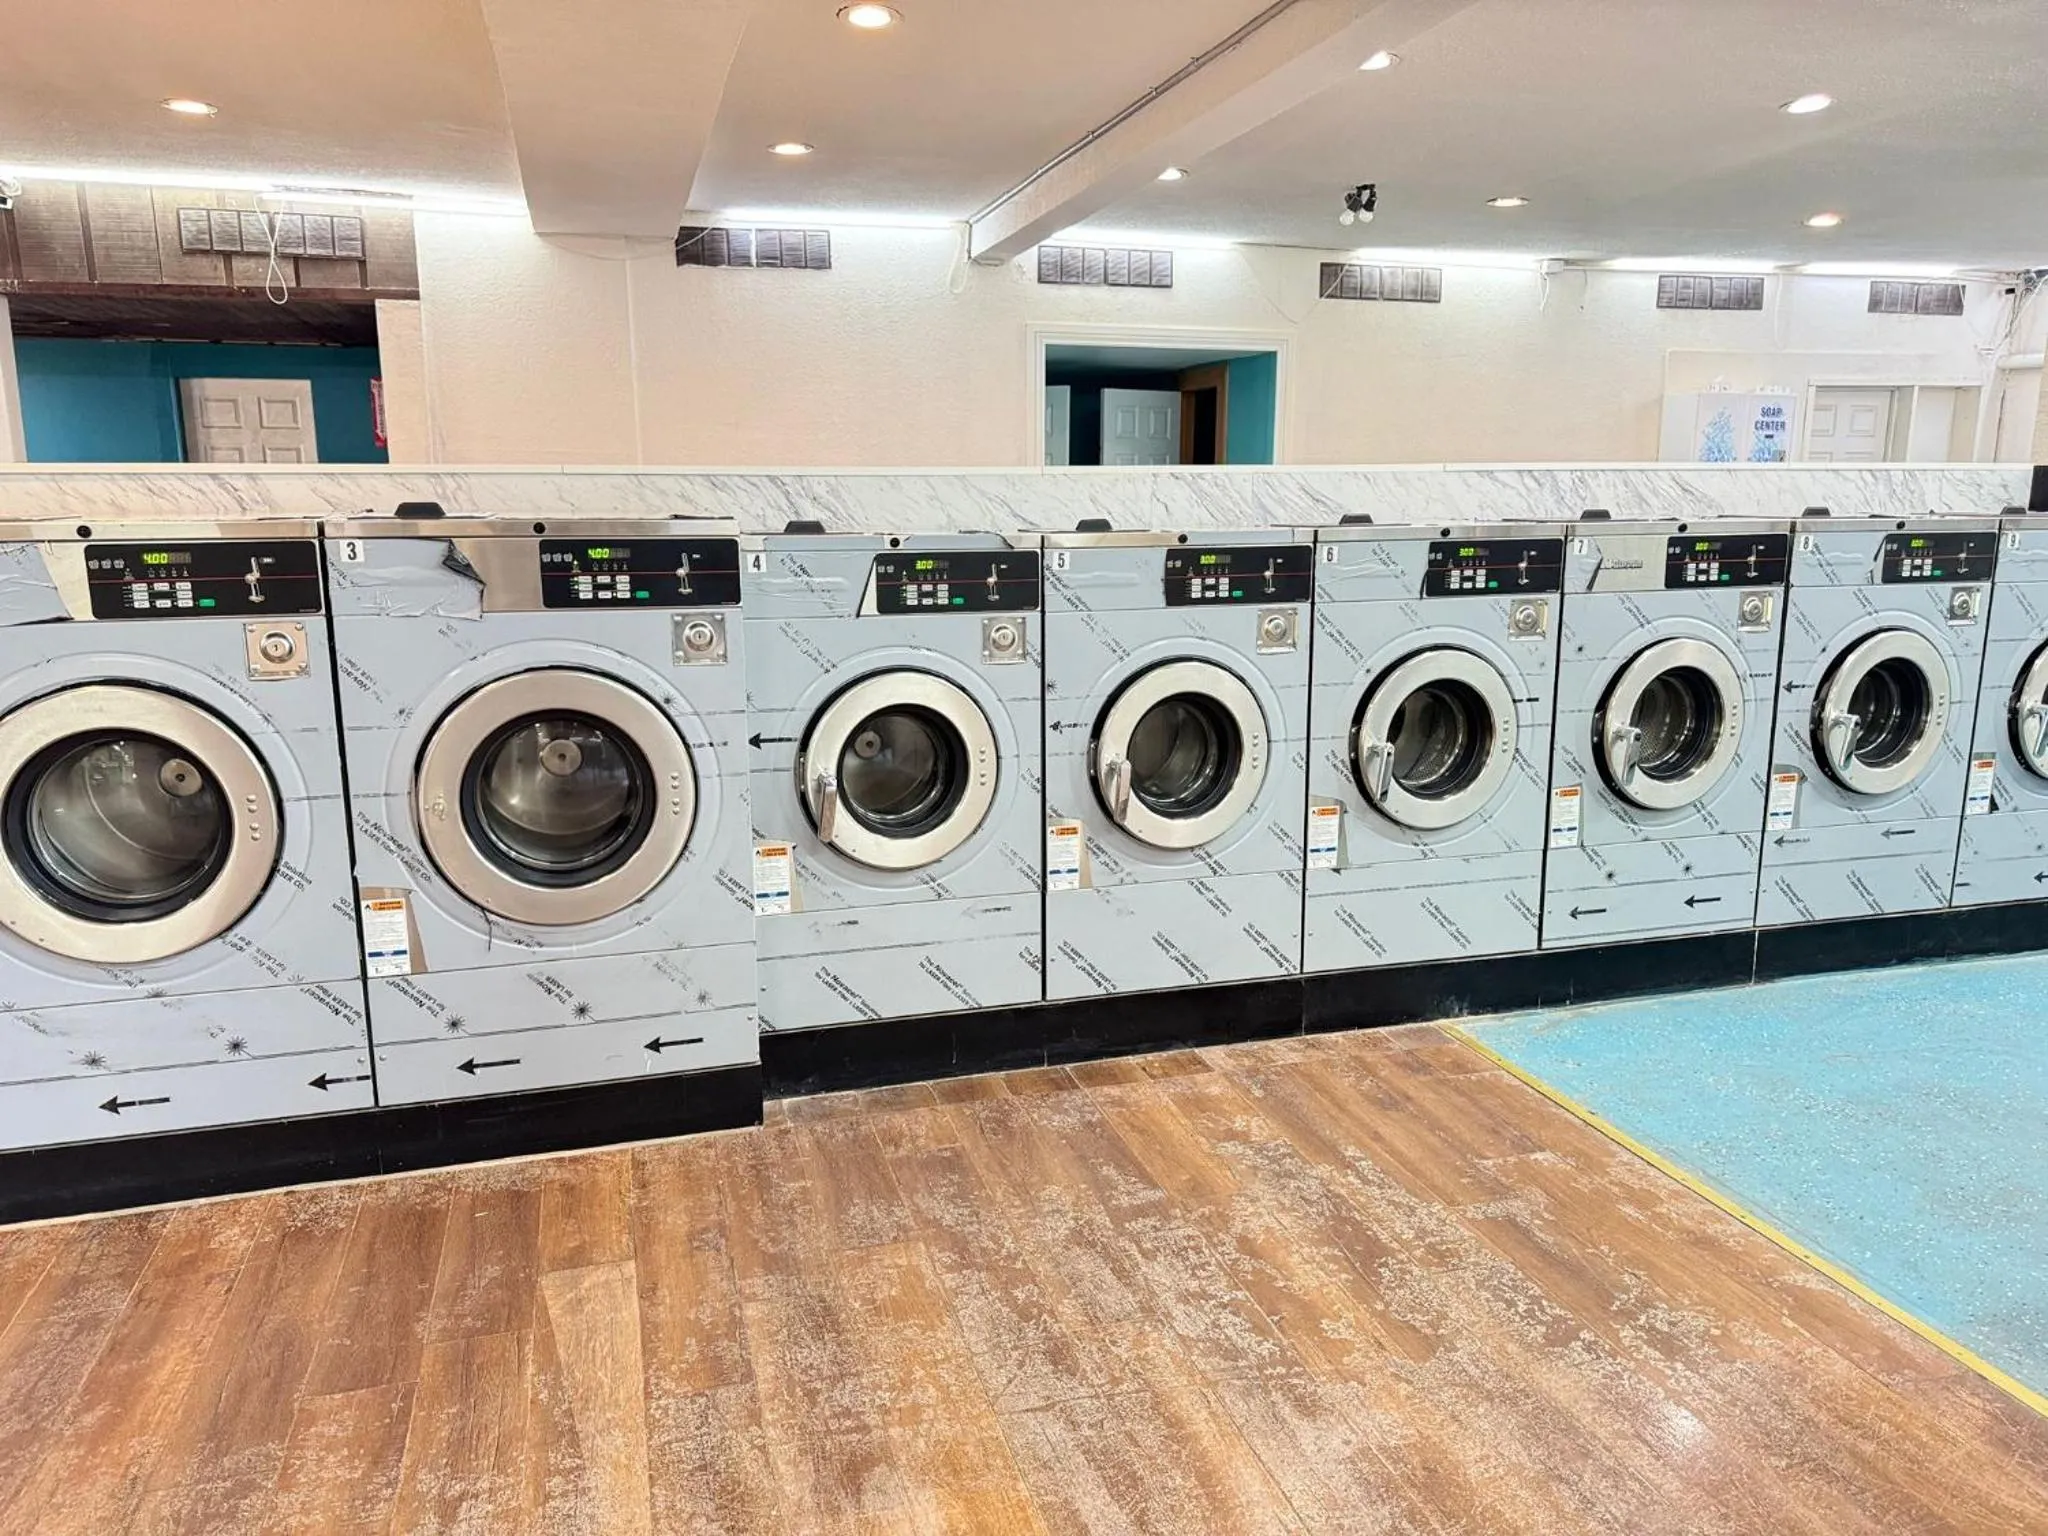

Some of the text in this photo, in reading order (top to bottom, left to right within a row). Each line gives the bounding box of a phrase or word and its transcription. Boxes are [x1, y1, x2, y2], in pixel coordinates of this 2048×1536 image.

[1760, 406, 1783, 418] SOAP
[1754, 420, 1785, 431] CENTER
[1578, 540, 1585, 553] 7
[1803, 536, 1810, 550] 8
[2010, 534, 2016, 547] 9
[346, 541, 357, 561] 3
[1326, 547, 1334, 561] 6
[752, 554, 762, 571] 4
[1057, 552, 1065, 568] 5
